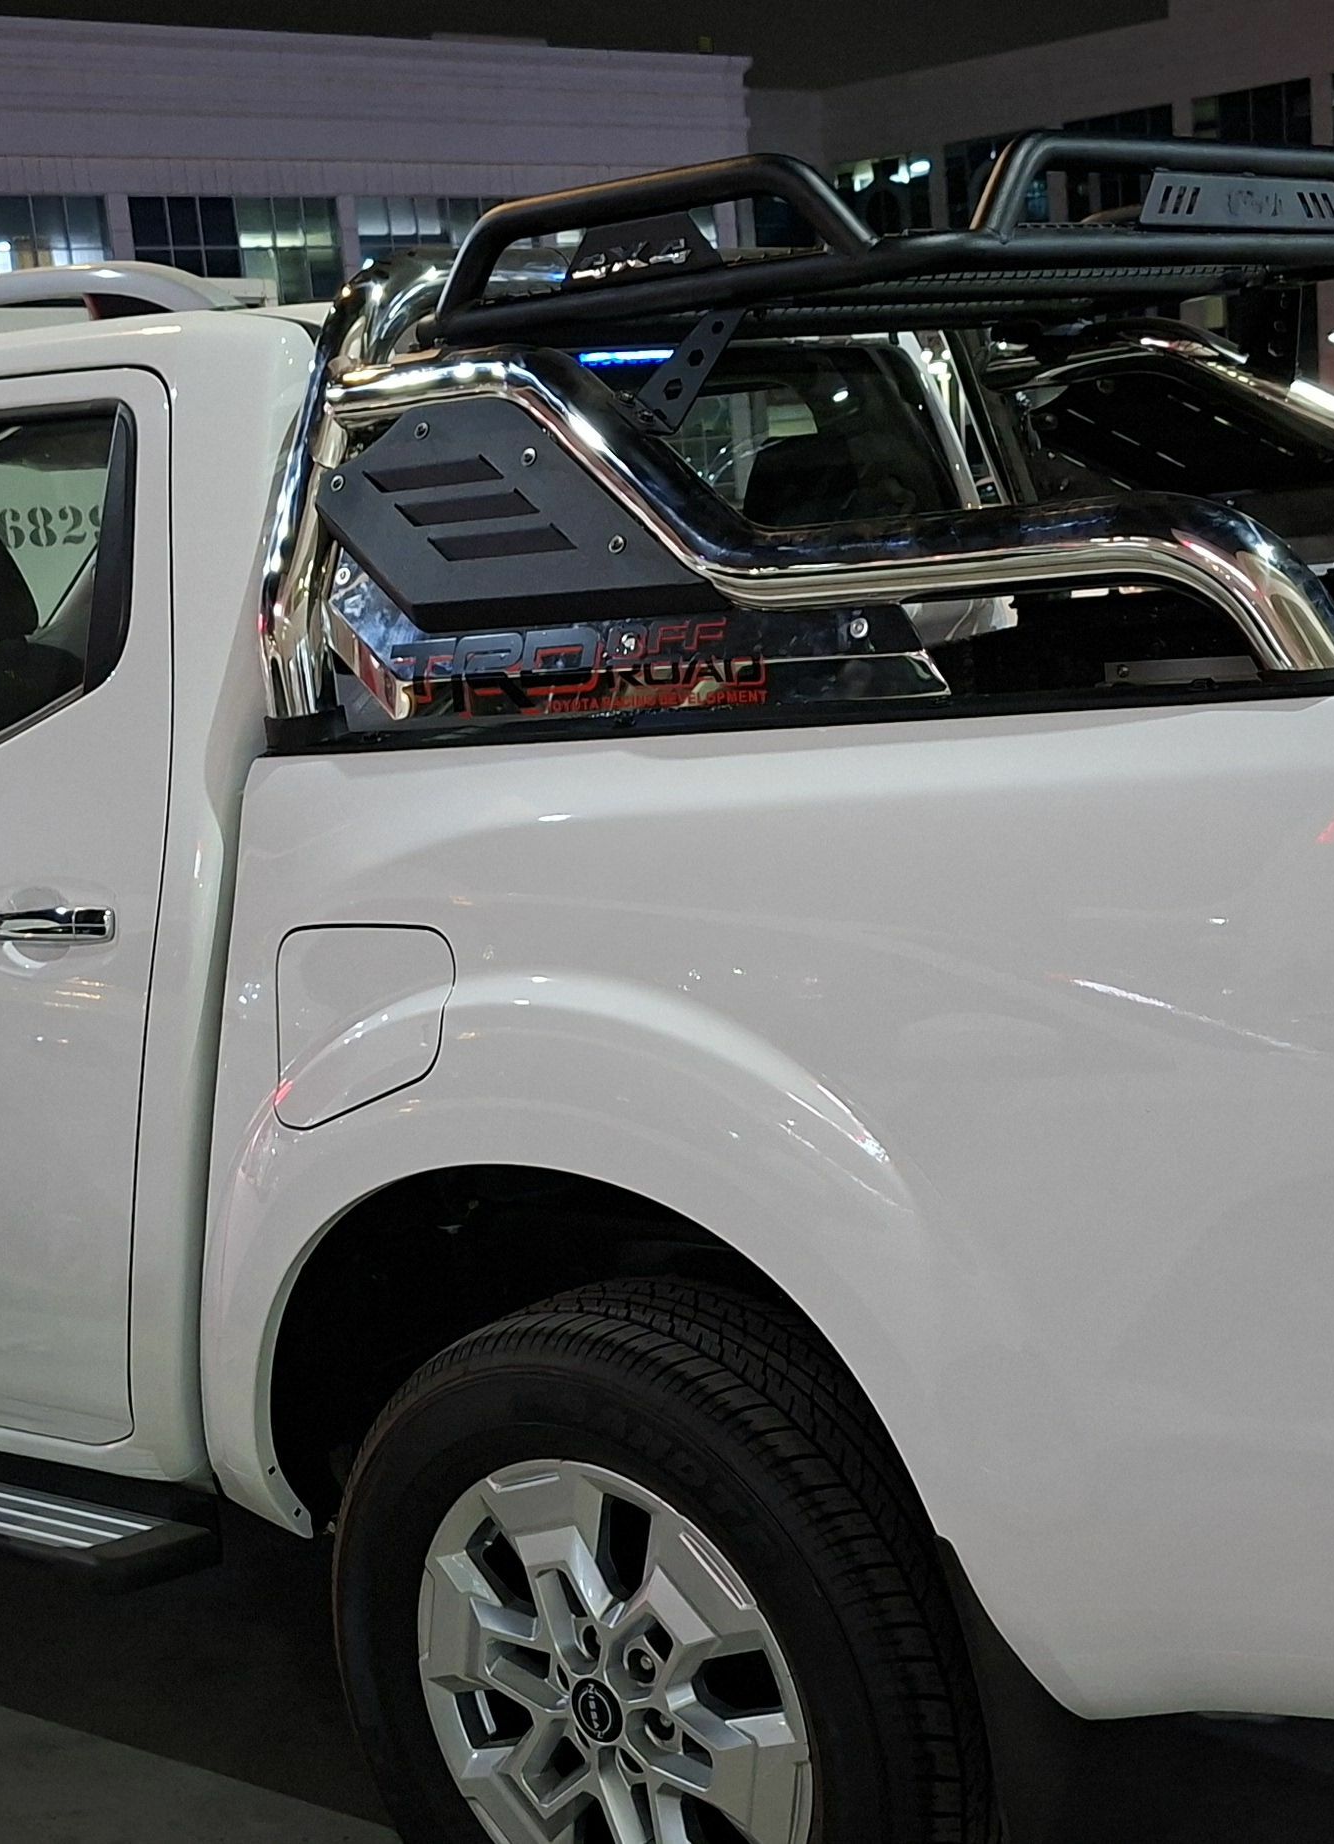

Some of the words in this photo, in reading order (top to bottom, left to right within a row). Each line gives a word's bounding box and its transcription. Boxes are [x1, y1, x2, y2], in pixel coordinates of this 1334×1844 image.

[606, 616, 727, 660] OFF
[391, 626, 603, 719] TRD
[605, 653, 766, 692] ROAD
